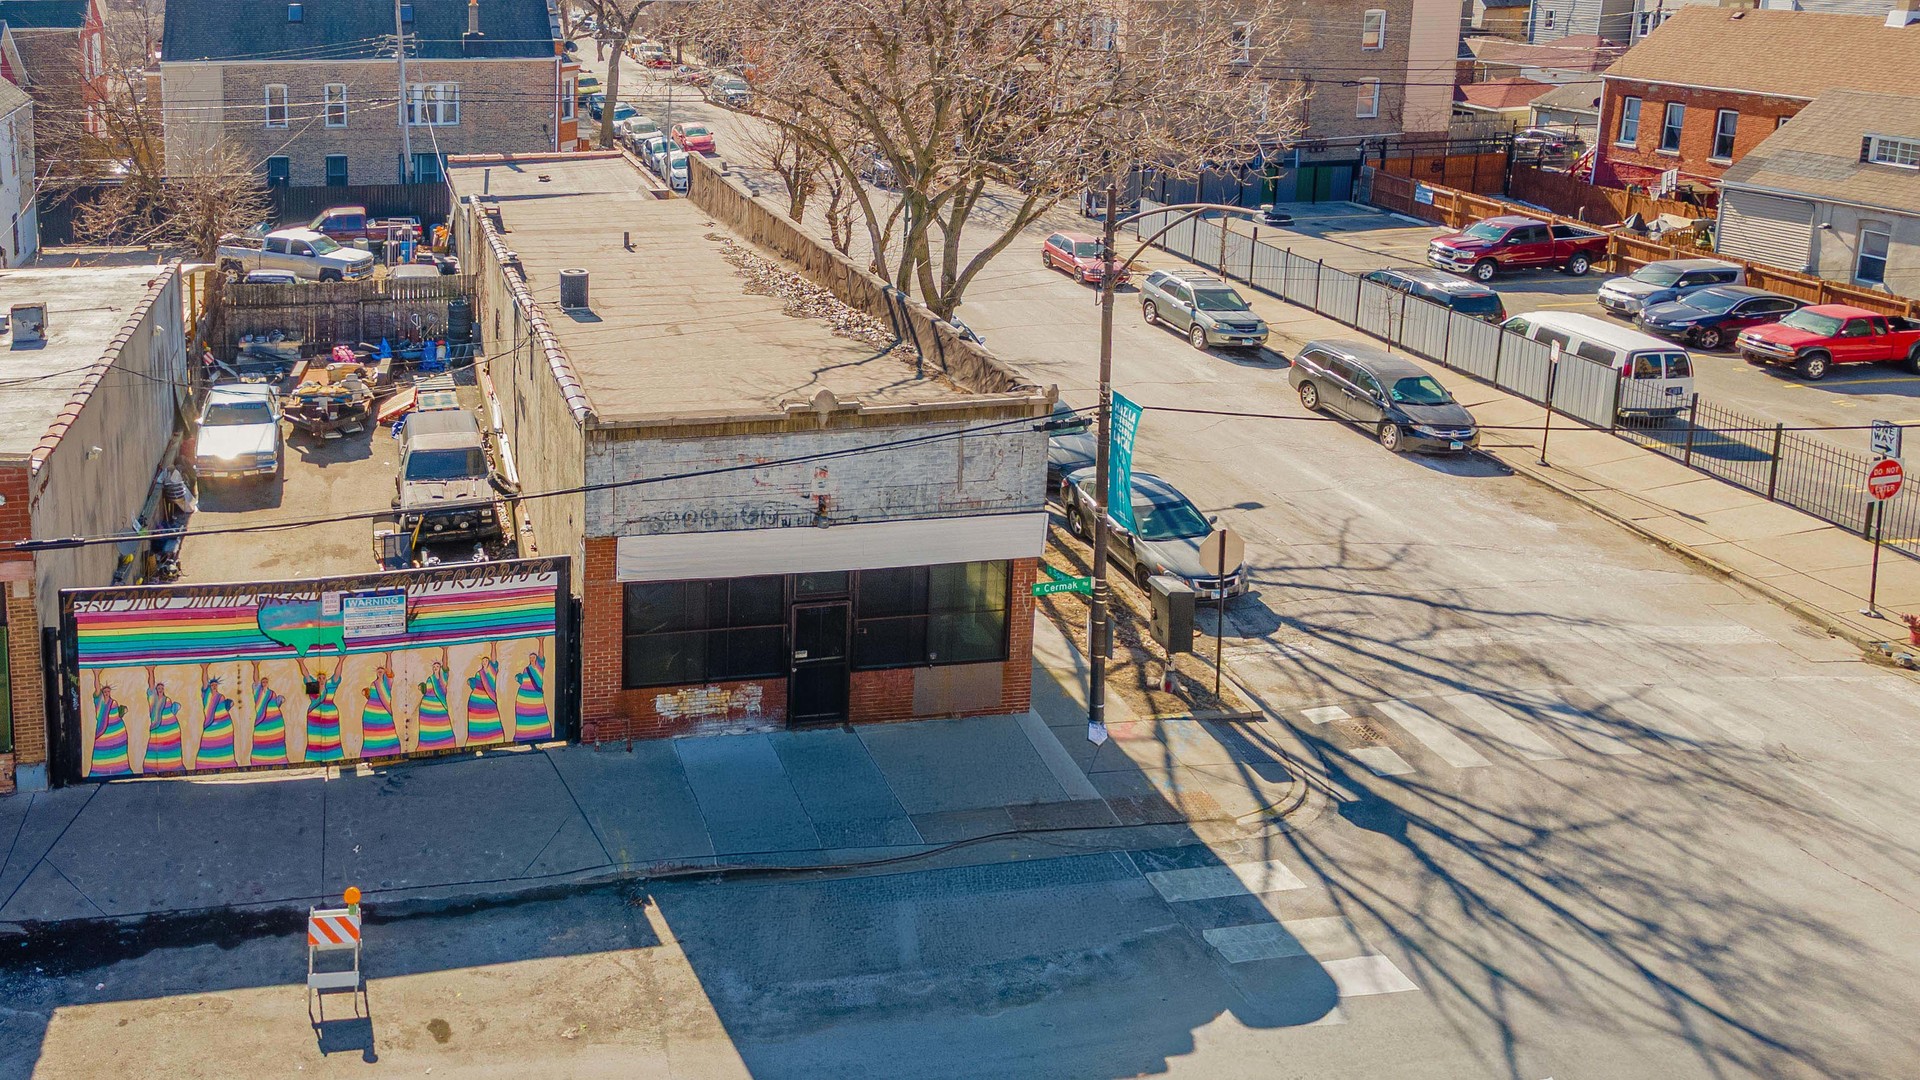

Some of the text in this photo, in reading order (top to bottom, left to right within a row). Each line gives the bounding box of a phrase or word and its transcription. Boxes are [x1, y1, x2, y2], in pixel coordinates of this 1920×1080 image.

[1875, 423, 1895, 436] ONE
[1874, 431, 1895, 444] WAY
[1873, 466, 1899, 476] DO NOT
[1875, 484, 1896, 493] ENTER
[65, 588, 173, 613] LATINO
[374, 559, 554, 595] CONTRIBUTE
[1044, 581, 1078, 592] Cermak
[348, 597, 399, 607] WARNING
